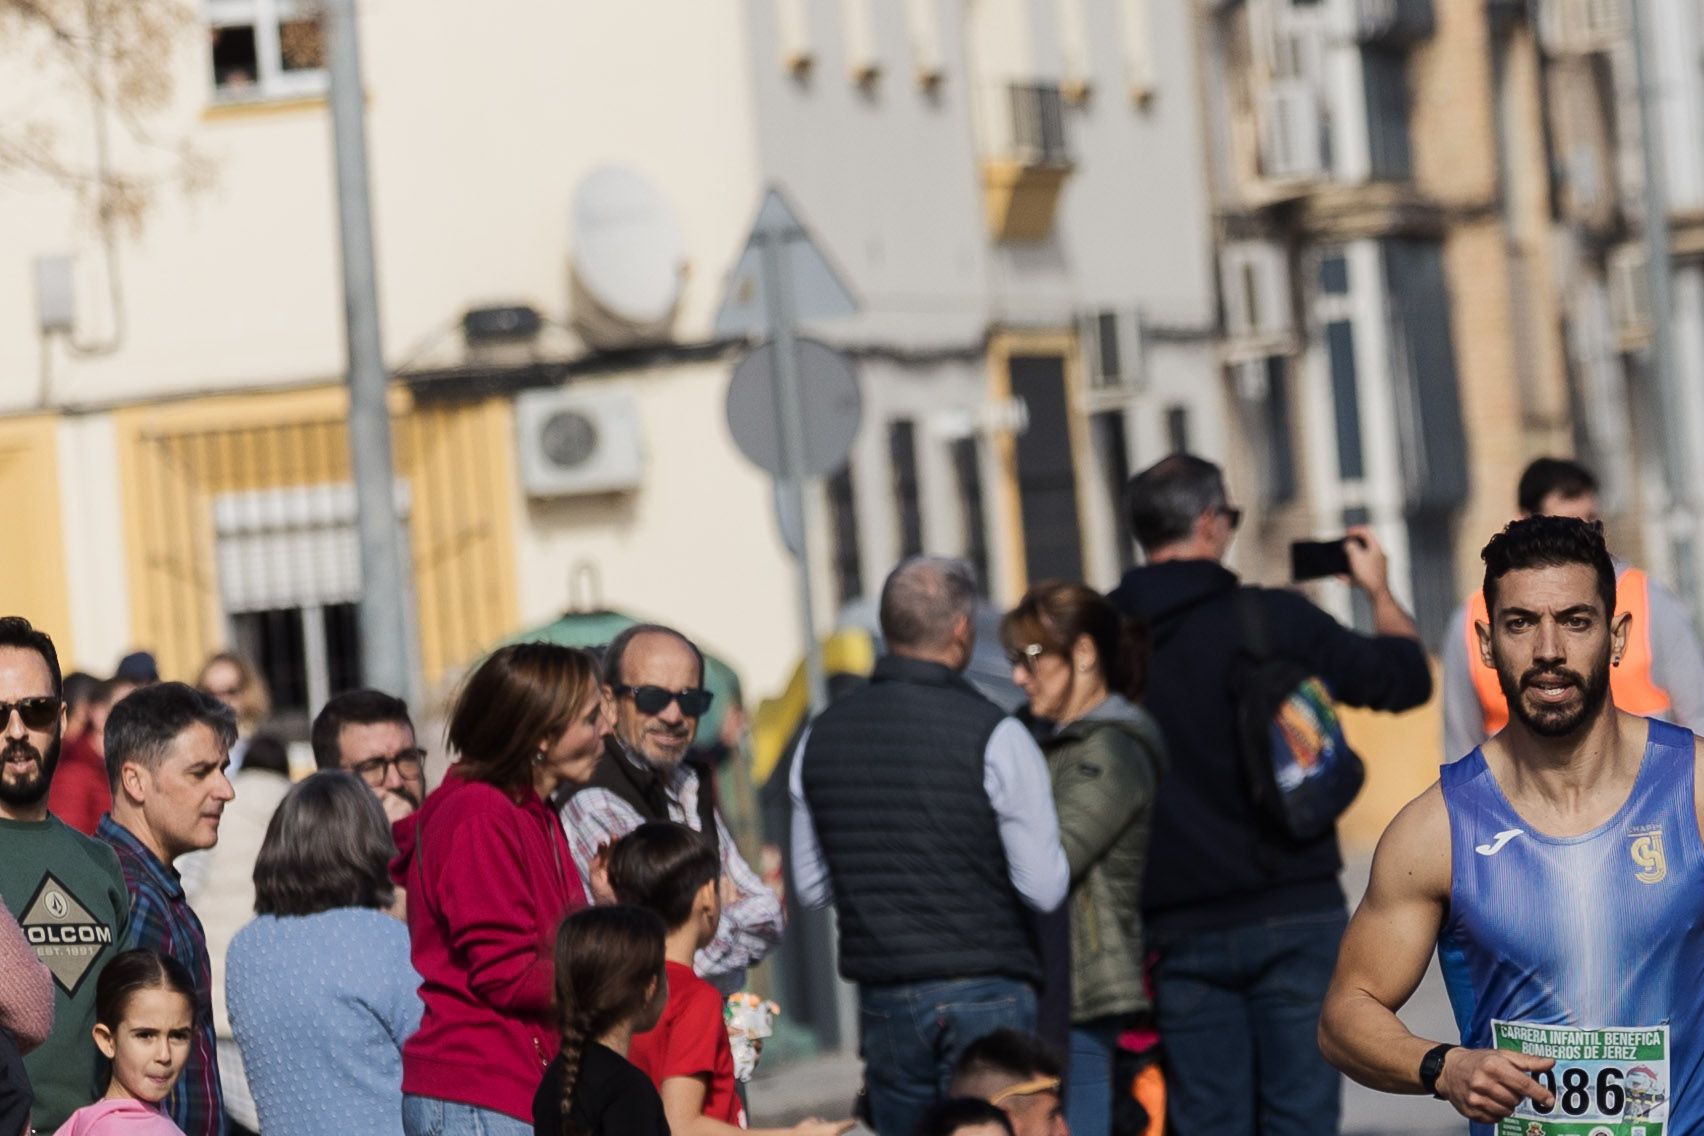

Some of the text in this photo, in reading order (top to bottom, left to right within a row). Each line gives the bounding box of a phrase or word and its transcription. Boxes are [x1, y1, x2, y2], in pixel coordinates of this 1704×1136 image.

[24, 925, 112, 944] OLCOM
[36, 947, 63, 957] EST.
[1501, 1023, 1547, 1044] CARRERA
[1550, 1030, 1602, 1046] INFANTIL
[1522, 1043, 1637, 1061] BOMBEROS DE JEREZ
[1531, 1067, 1624, 1116] 086
